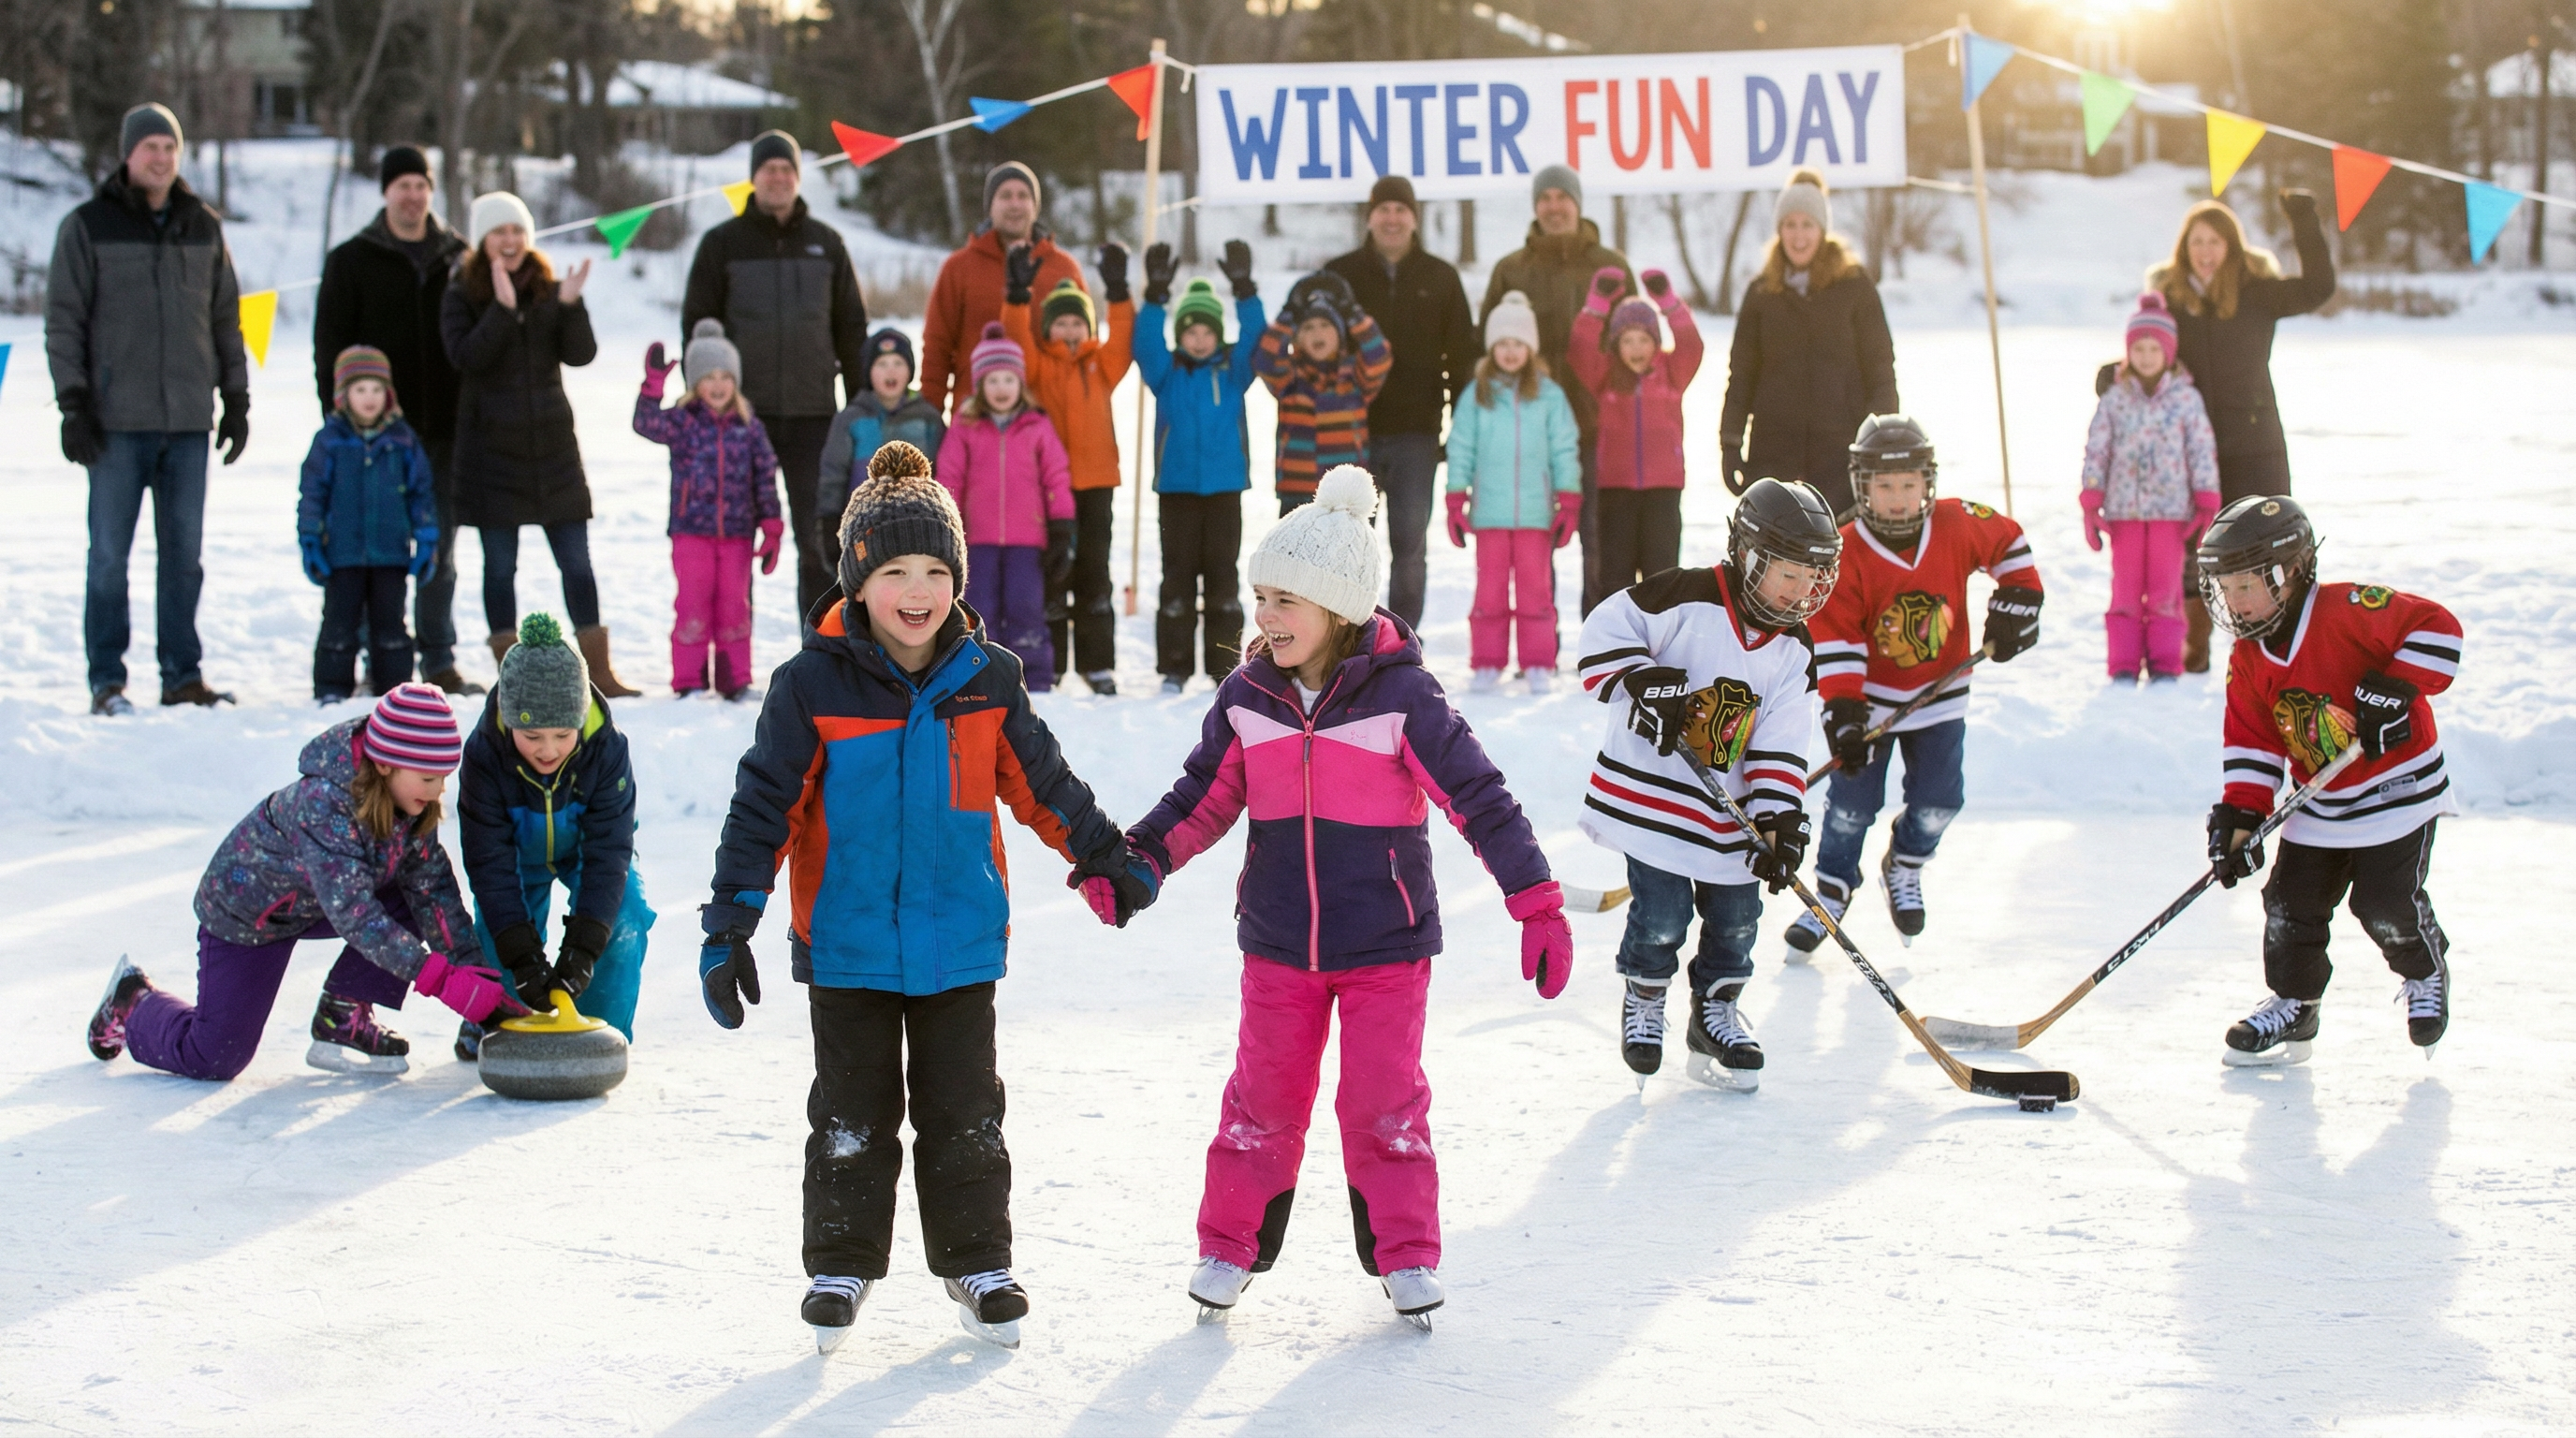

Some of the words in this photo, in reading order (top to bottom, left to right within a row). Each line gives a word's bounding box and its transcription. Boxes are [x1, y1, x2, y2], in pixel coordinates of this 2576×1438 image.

[1218, 81, 1530, 182] WINTER
[1564, 77, 1712, 172] FUN
[1745, 71, 1881, 167] DAY
[1643, 682, 1691, 699] BAU
[2354, 685, 2402, 710] UER
